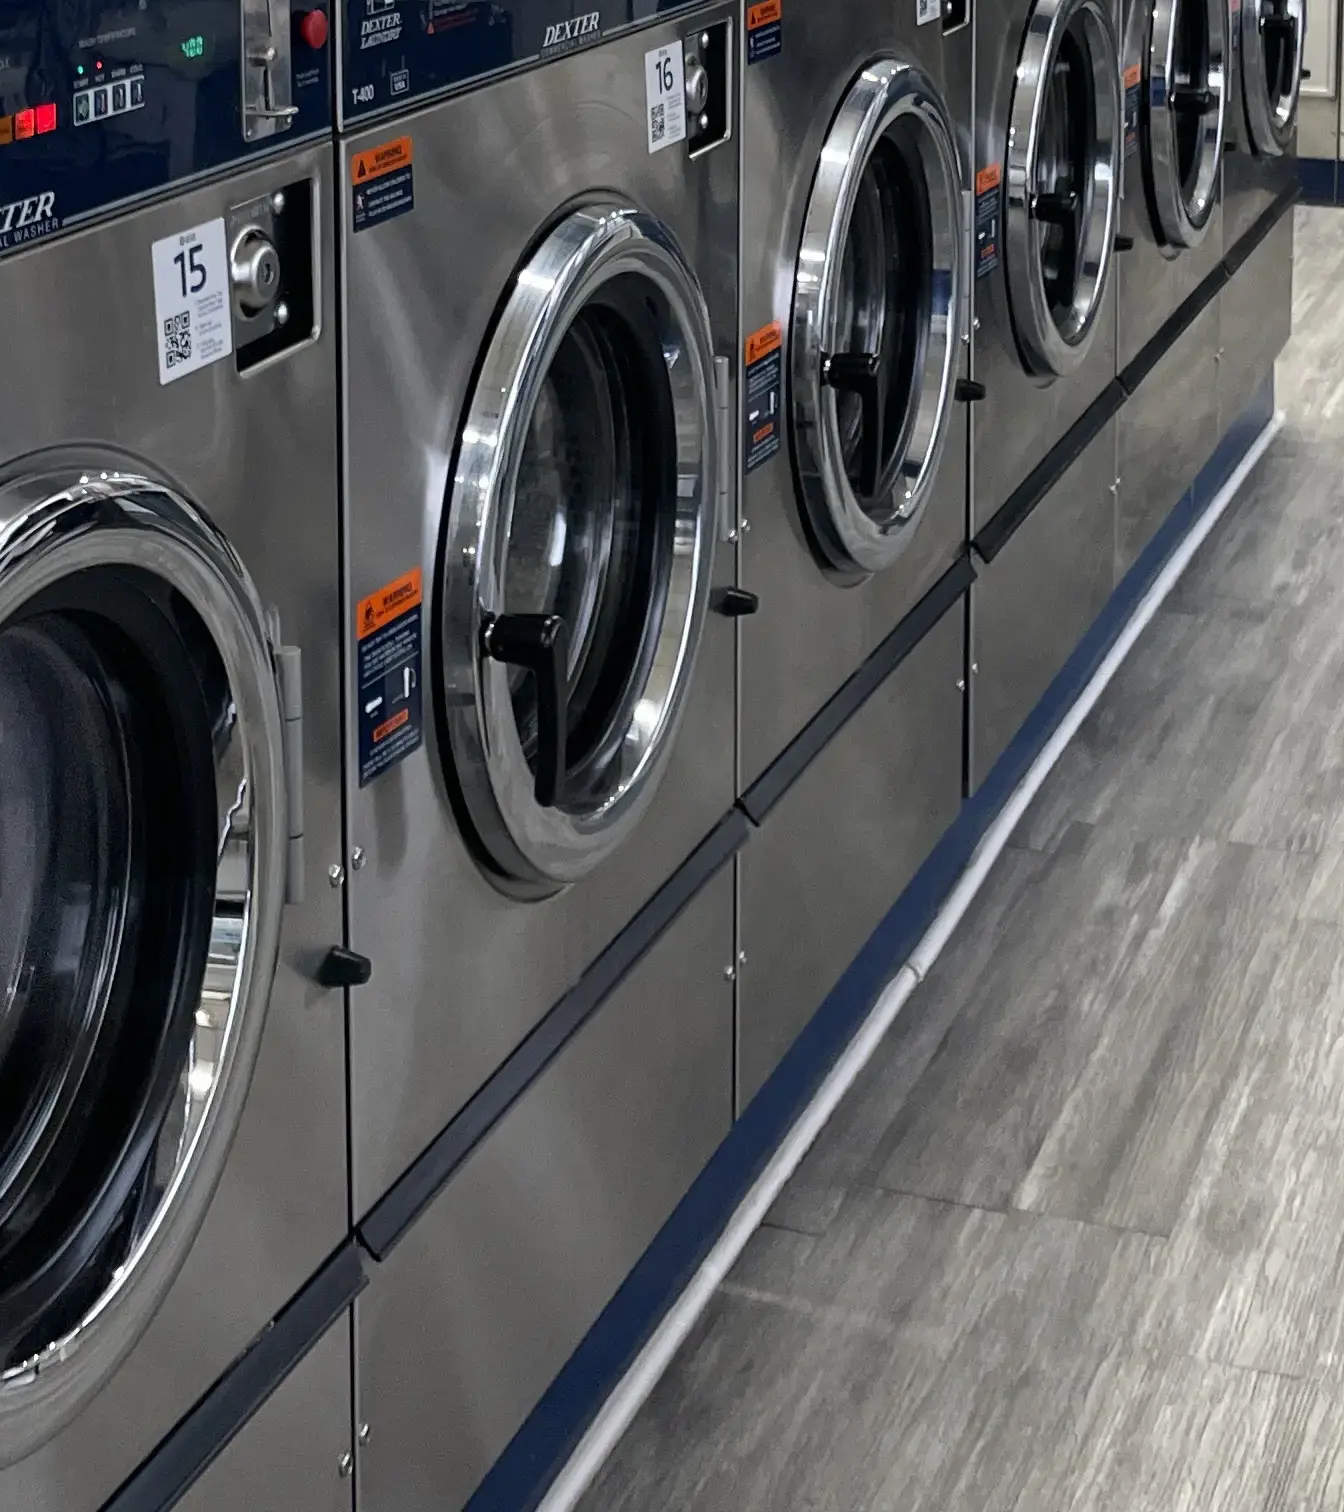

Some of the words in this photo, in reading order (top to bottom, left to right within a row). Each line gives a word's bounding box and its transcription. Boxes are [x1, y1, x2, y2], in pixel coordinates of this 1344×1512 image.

[361, 12, 402, 36] DEXTER
[543, 11, 600, 48] DEXTER
[655, 56, 674, 95] 16
[13, 218, 59, 243] WASHER
[173, 243, 207, 298] 15
